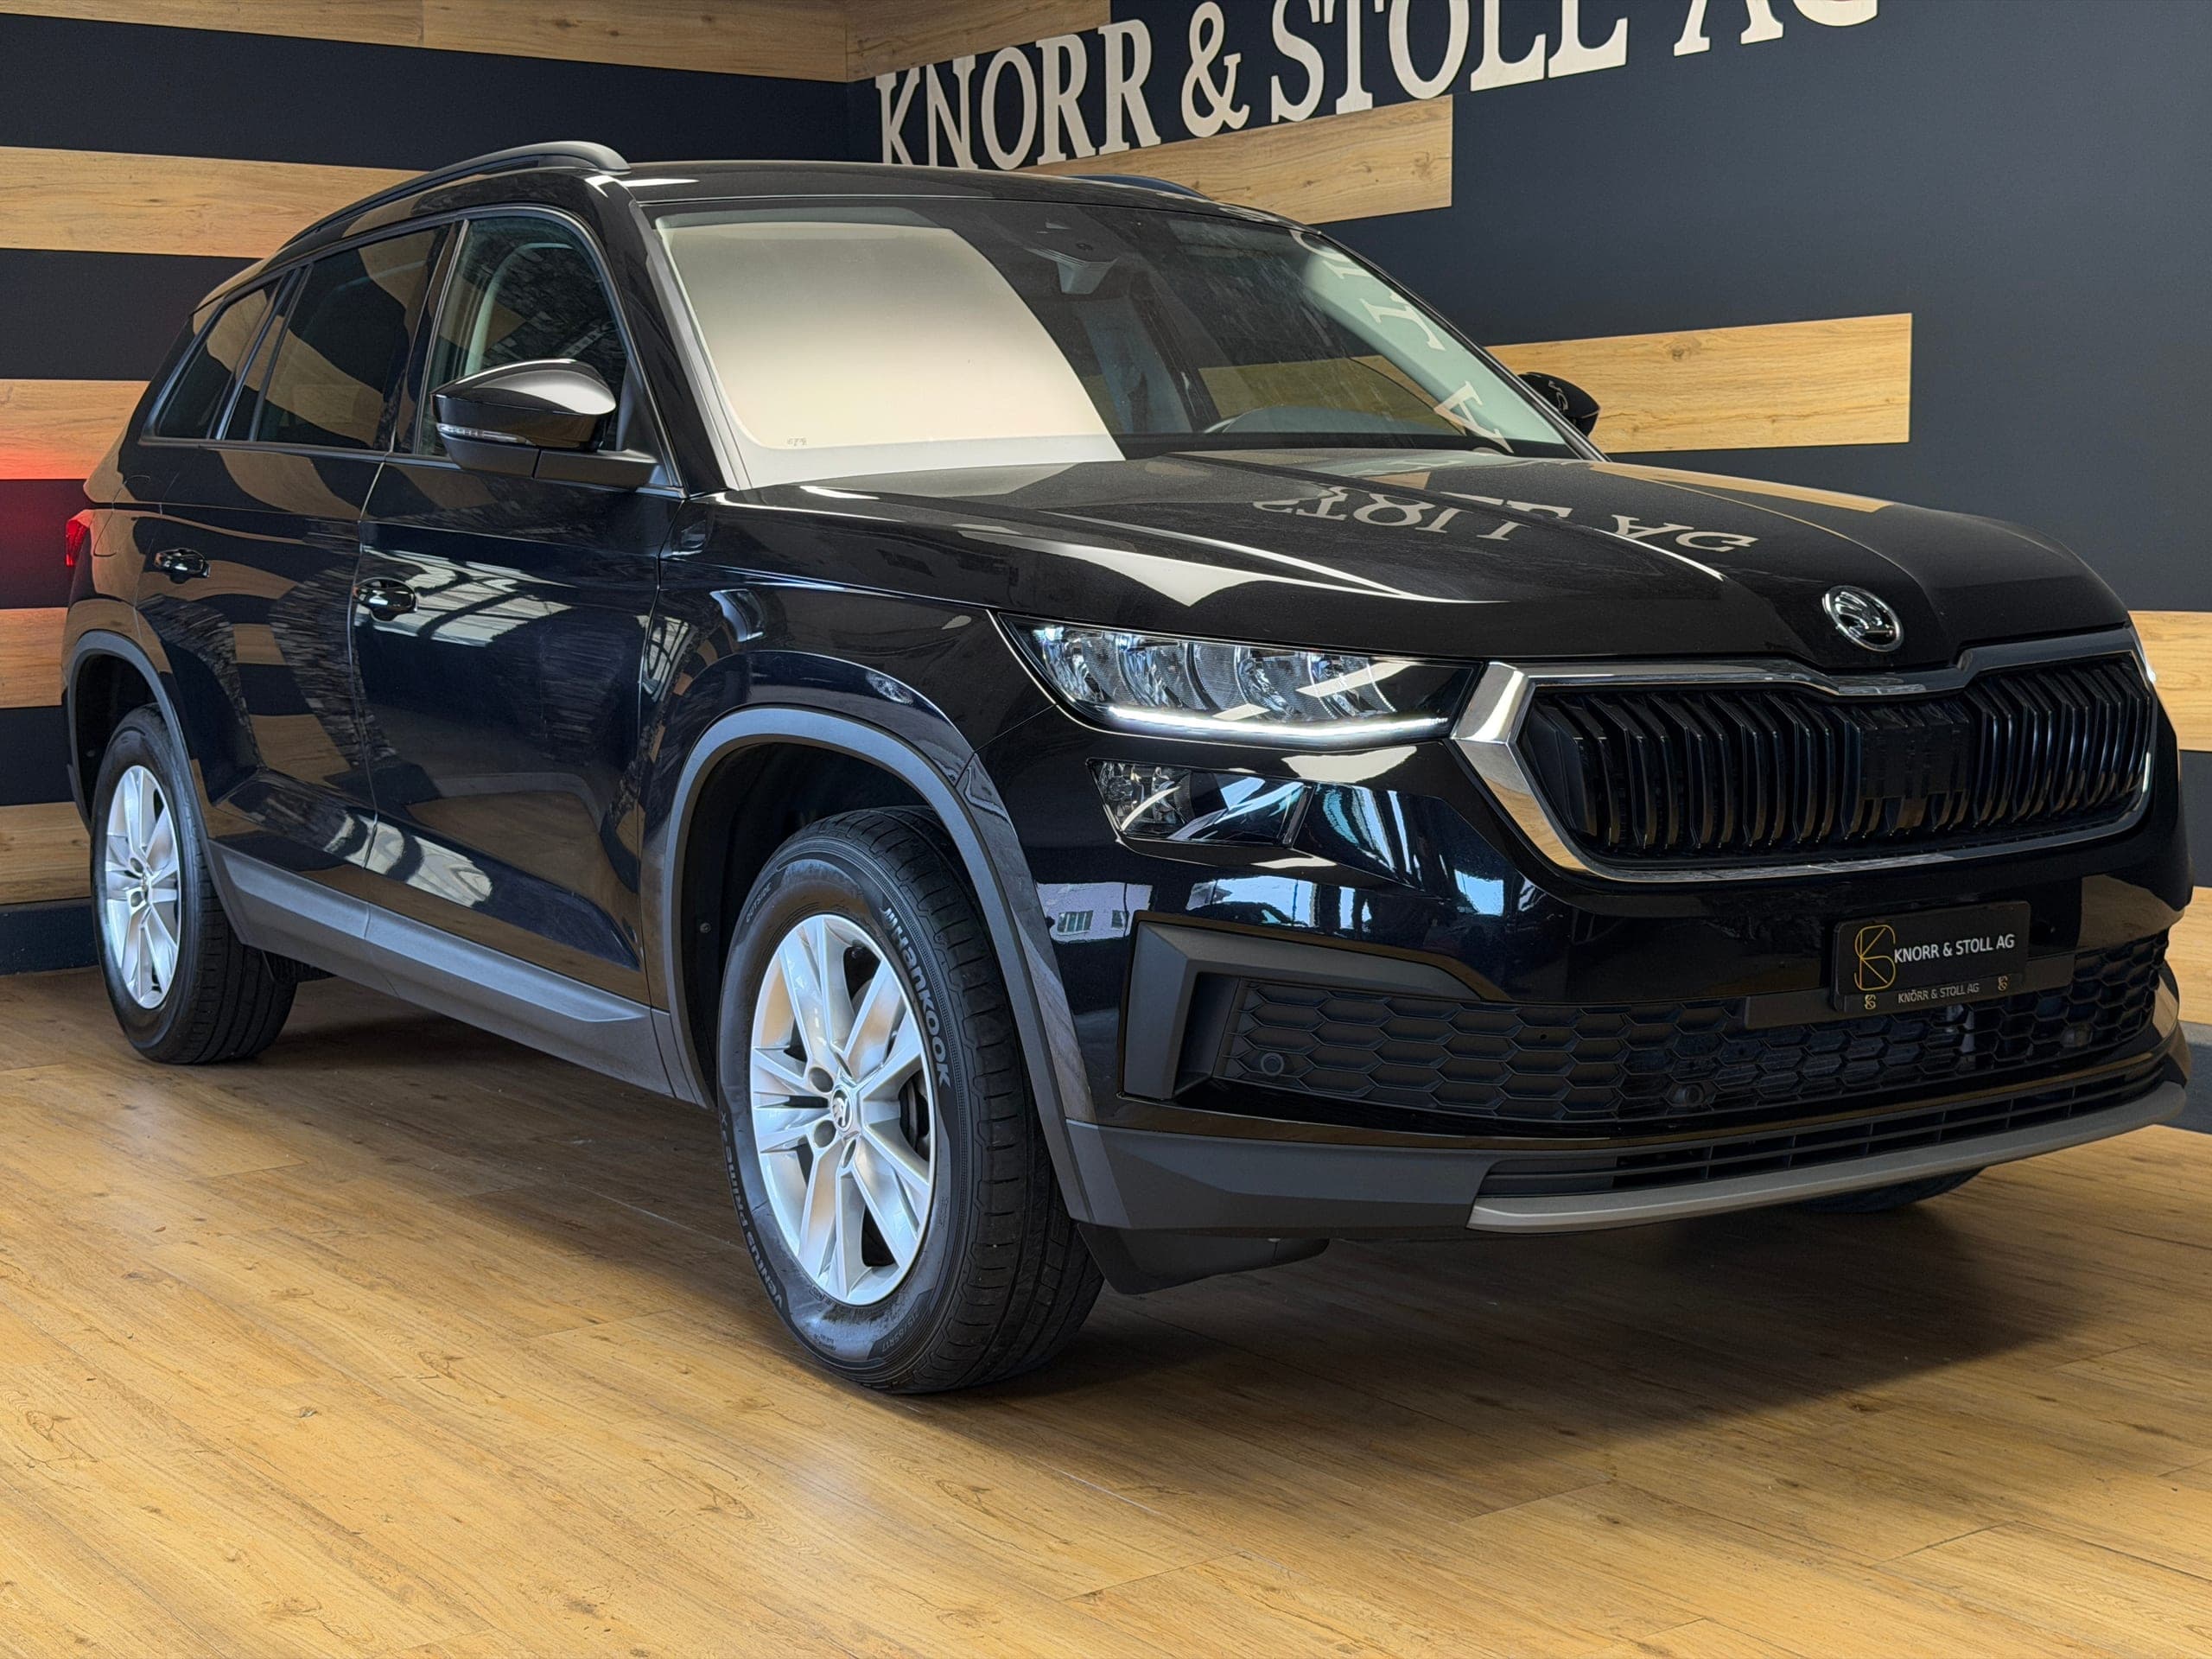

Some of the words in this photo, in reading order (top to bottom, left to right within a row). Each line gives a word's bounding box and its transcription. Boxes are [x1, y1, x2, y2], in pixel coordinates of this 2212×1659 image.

[875, 19, 1160, 170] KNORR
[1181, 1, 1250, 137] &
[1894, 944, 1940, 963] KNORR
[1942, 942, 1953, 957] &
[1955, 936, 1994, 955] STOLL
[1996, 934, 2015, 950] AG
[1931, 988, 1939, 1000] &
[1940, 985, 1967, 998] STOLL
[1967, 982, 1980, 995] AG
